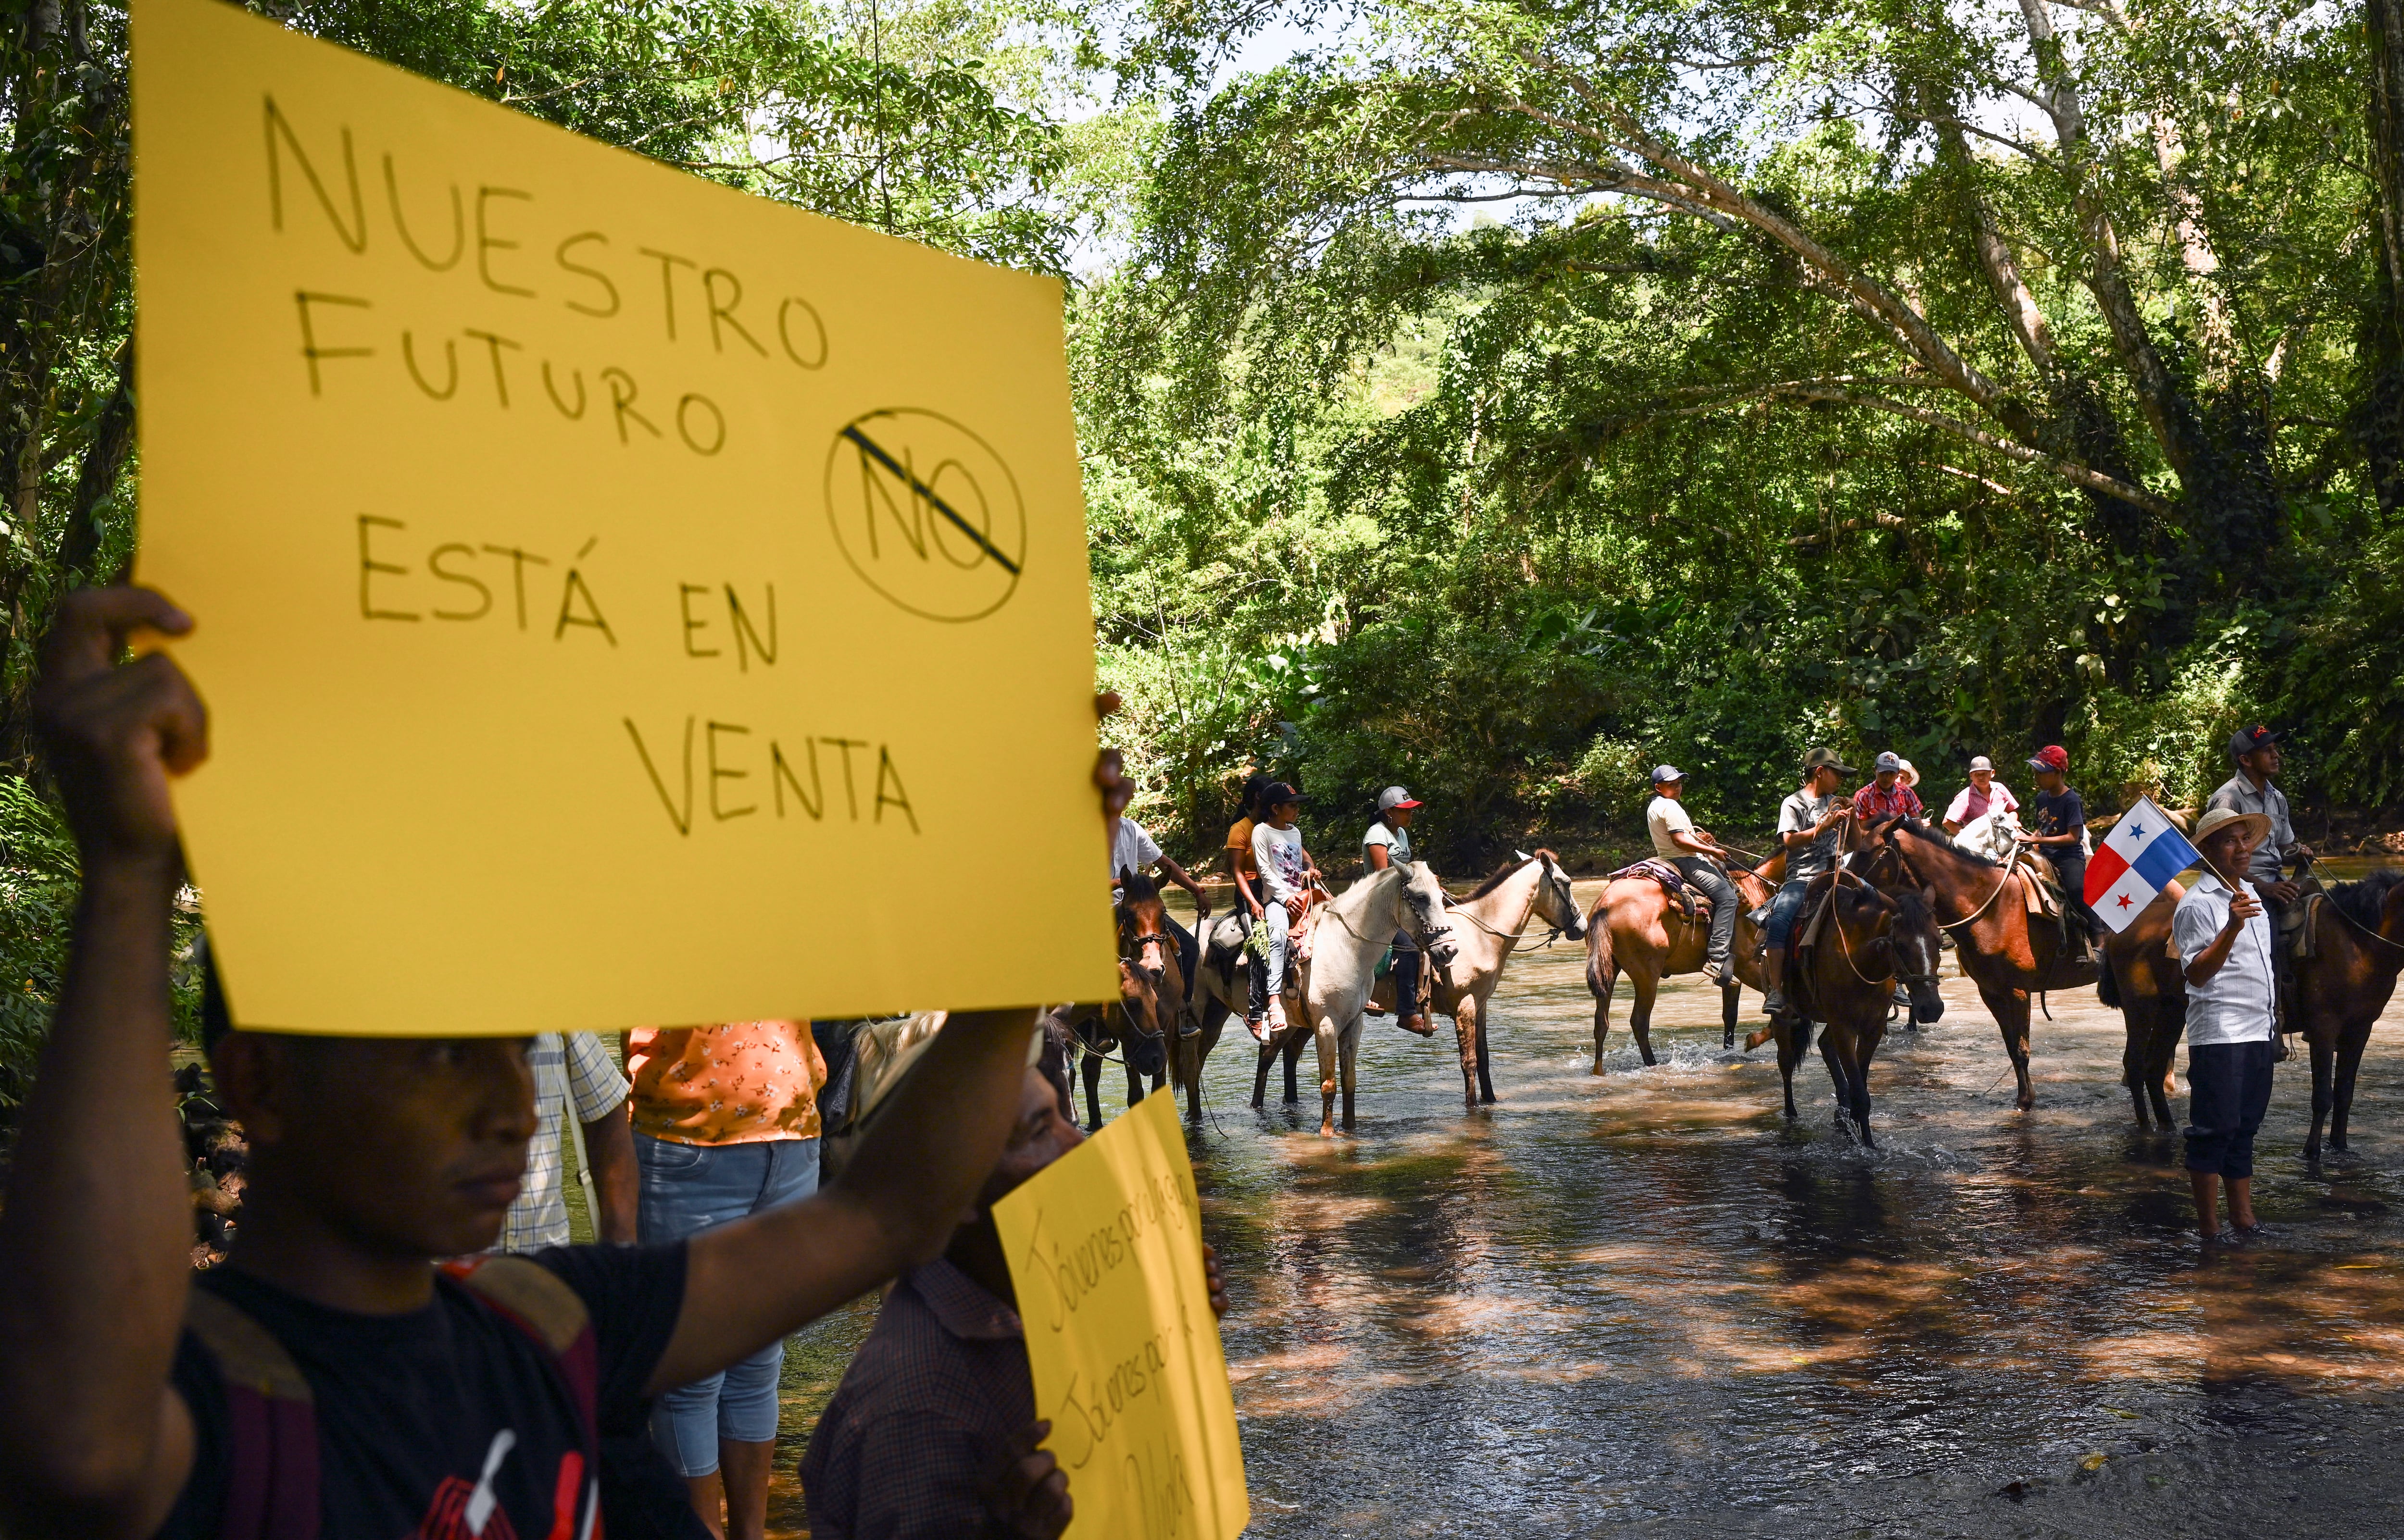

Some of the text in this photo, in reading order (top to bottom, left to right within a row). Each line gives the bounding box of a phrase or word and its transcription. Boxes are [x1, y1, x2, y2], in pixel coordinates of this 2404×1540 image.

[263, 91, 831, 372] NUESTRO
[293, 288, 727, 456] FUTURO
[856, 444, 992, 571] NO
[356, 513, 777, 674] ESTÁ EN
[621, 713, 922, 837] VENTA
